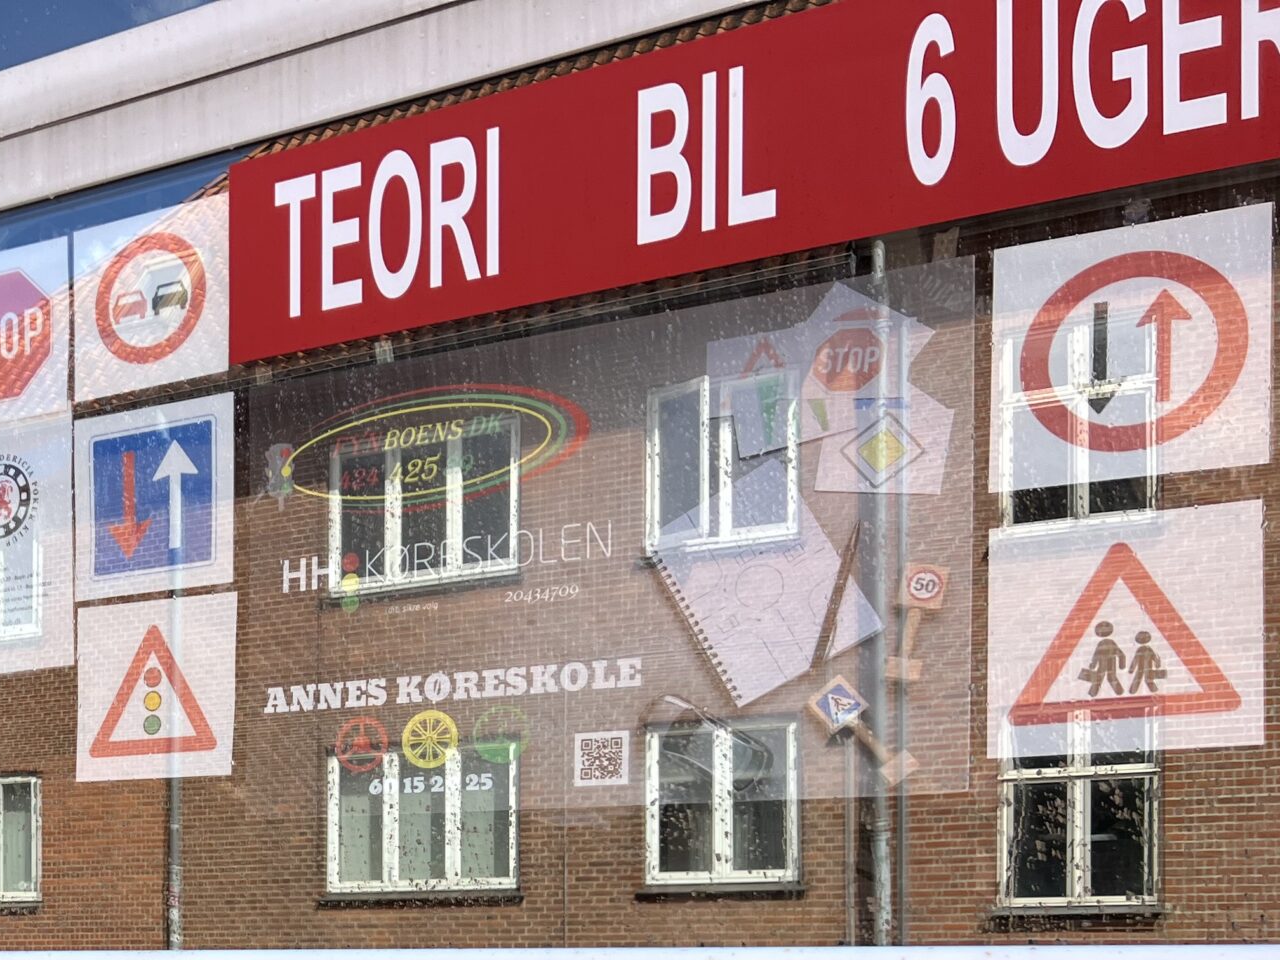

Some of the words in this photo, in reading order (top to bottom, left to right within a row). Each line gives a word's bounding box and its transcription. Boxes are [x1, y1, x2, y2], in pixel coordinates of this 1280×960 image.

[274, 127, 500, 318] TEORI
[636, 66, 776, 245] BIL
[906, 13, 956, 186] 6
[818, 346, 880, 374] STOP
[504, 583, 580, 604] 20434709
[913, 577, 936, 593] 50
[264, 678, 388, 713] ANNES
[396, 658, 641, 703] KØRESKOLE
